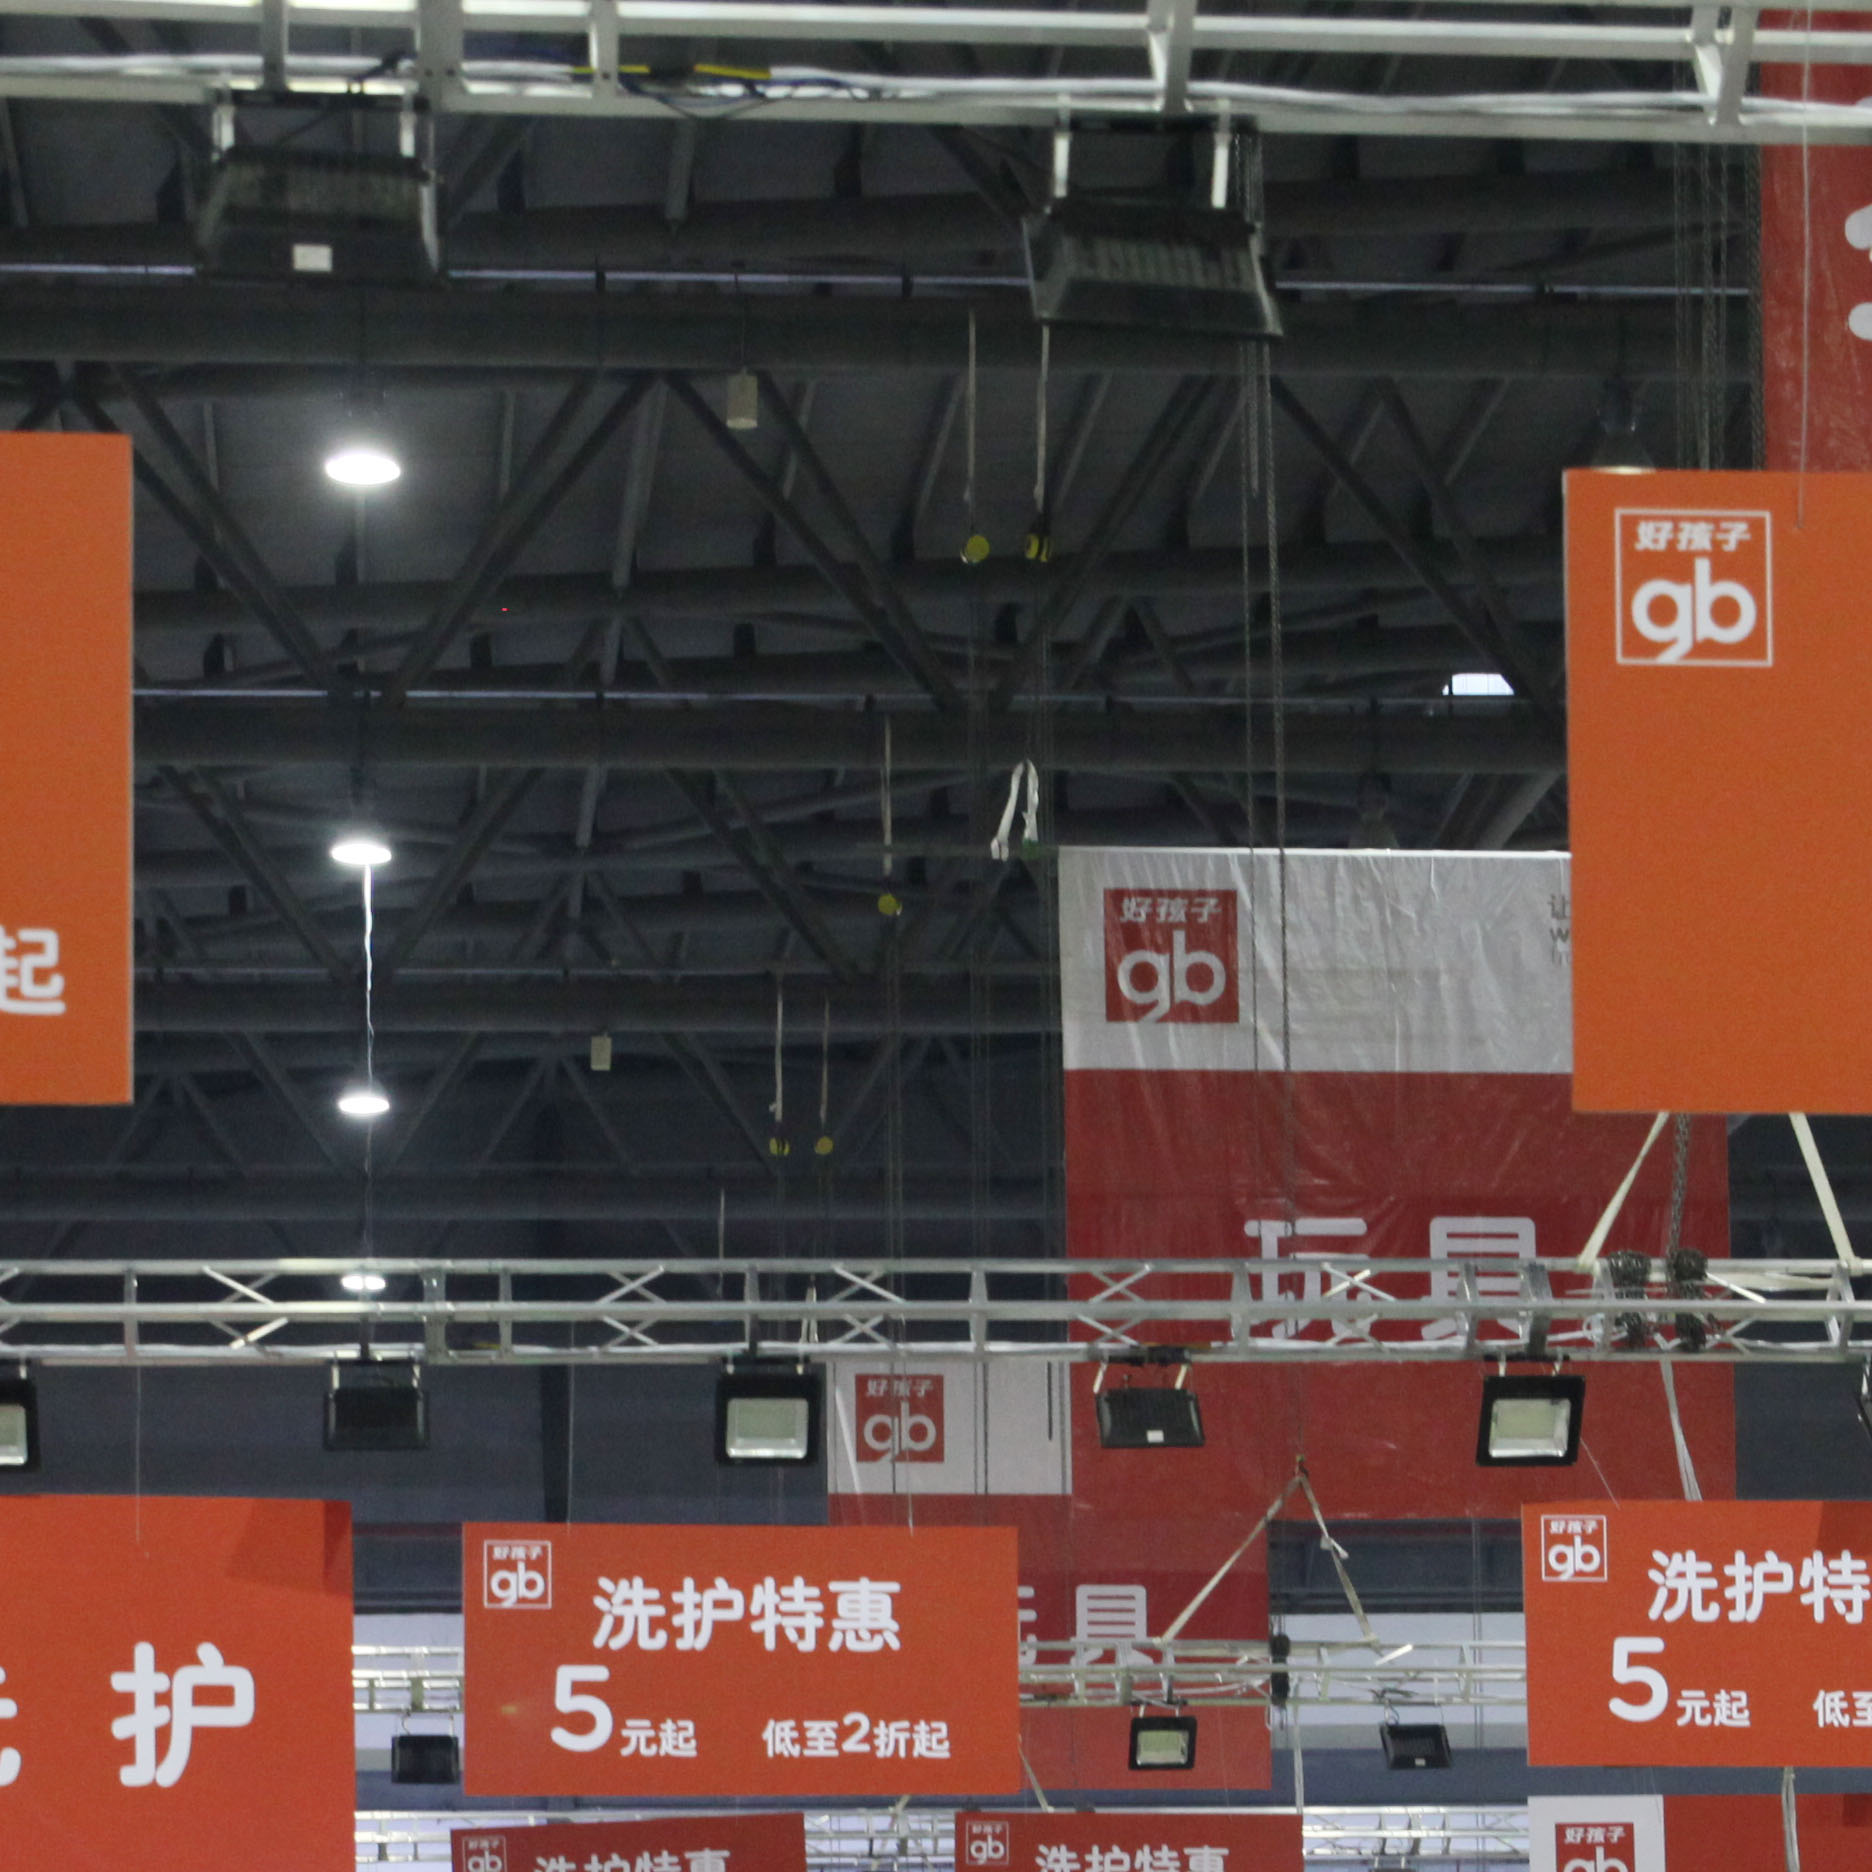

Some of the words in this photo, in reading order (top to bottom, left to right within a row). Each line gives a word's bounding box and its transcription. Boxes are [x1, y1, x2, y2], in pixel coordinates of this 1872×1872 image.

[1635, 519, 1752, 551] 好孩子
[1631, 556, 1758, 664] gb
[1120, 896, 1221, 923] 好孩子
[1116, 930, 1227, 1022] gb
[863, 1402, 937, 1462] gb
[489, 1561, 546, 1606] gb
[1547, 1536, 1601, 1578] gb
[593, 1576, 900, 1652] 洗护特惠
[551, 1665, 697, 1757] 5元起
[762, 1712, 950, 1758] 低至2折起
[1609, 1637, 1750, 1726] 5元起
